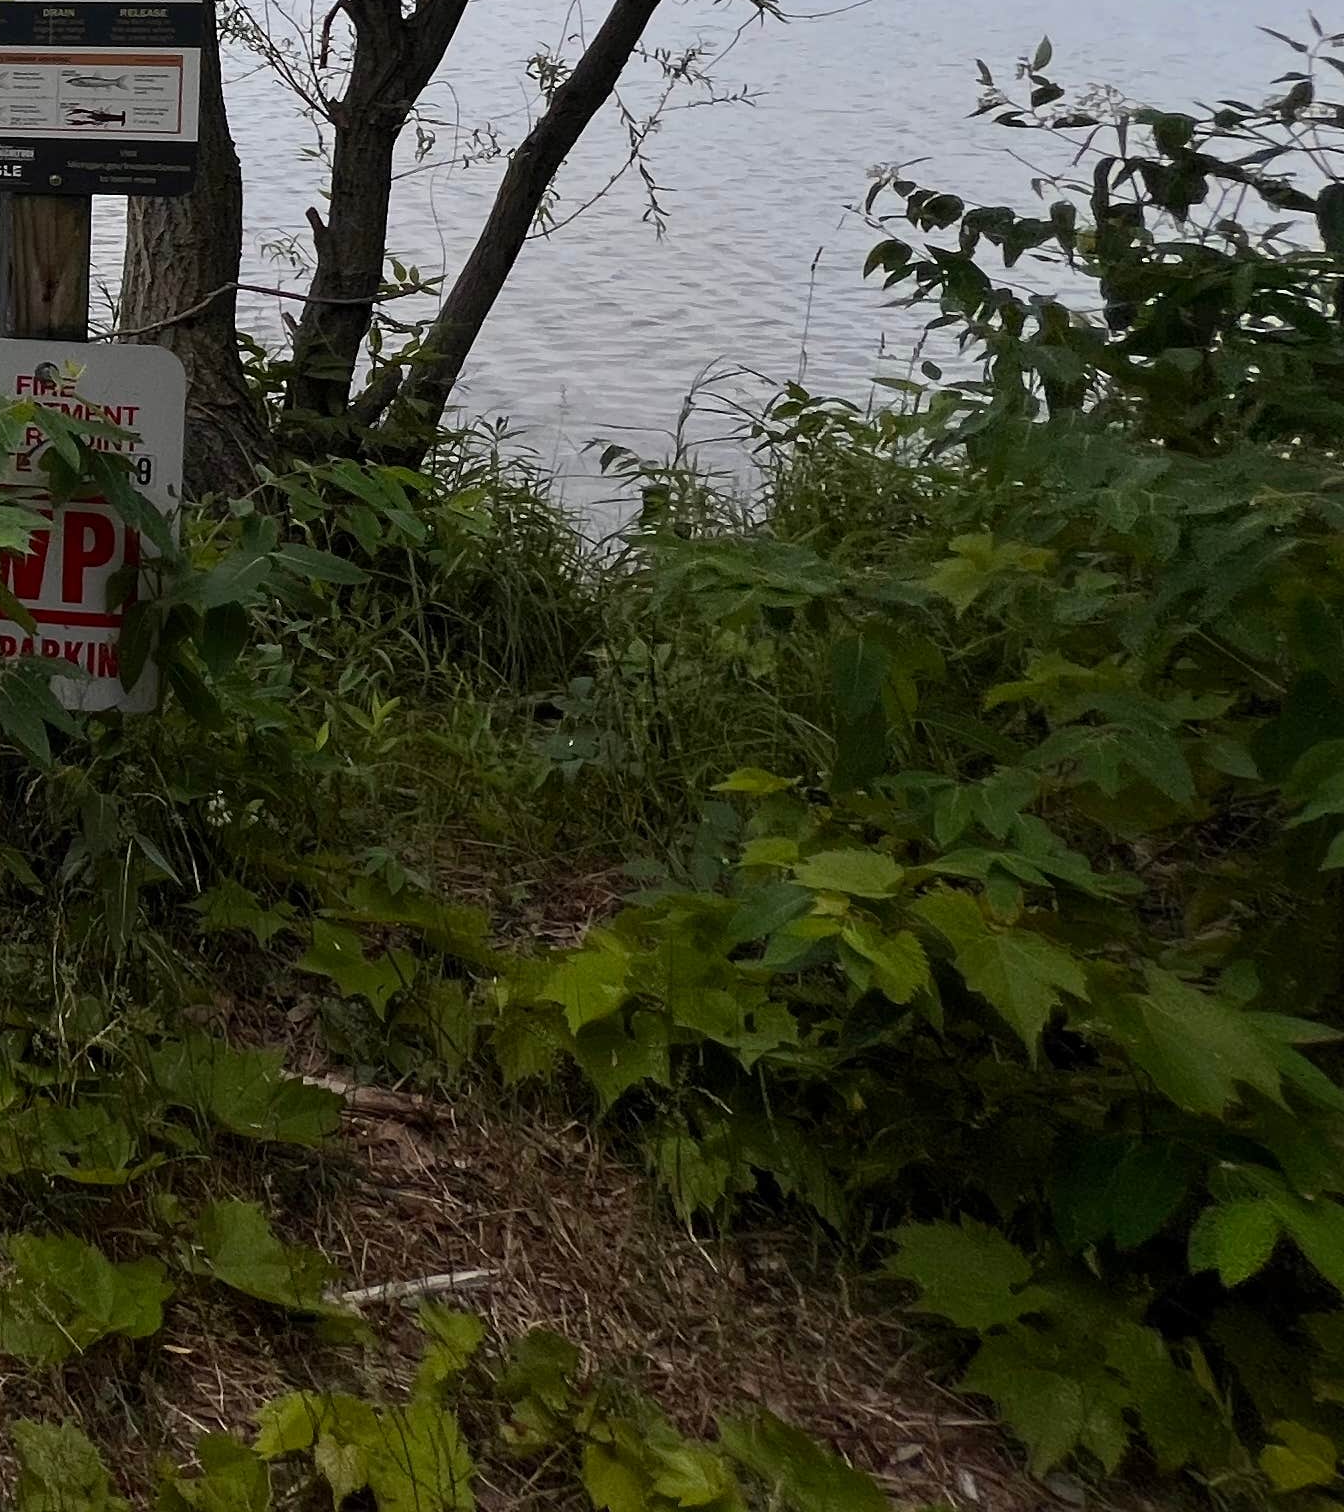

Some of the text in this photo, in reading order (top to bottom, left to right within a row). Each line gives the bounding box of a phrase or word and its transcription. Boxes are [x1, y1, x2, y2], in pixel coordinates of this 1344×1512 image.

[42, 8, 76, 18] DRAIN
[119, 8, 168, 18] RELEASE
[16, 375, 76, 397] FIRE
[0, 635, 120, 678] PRKIN
